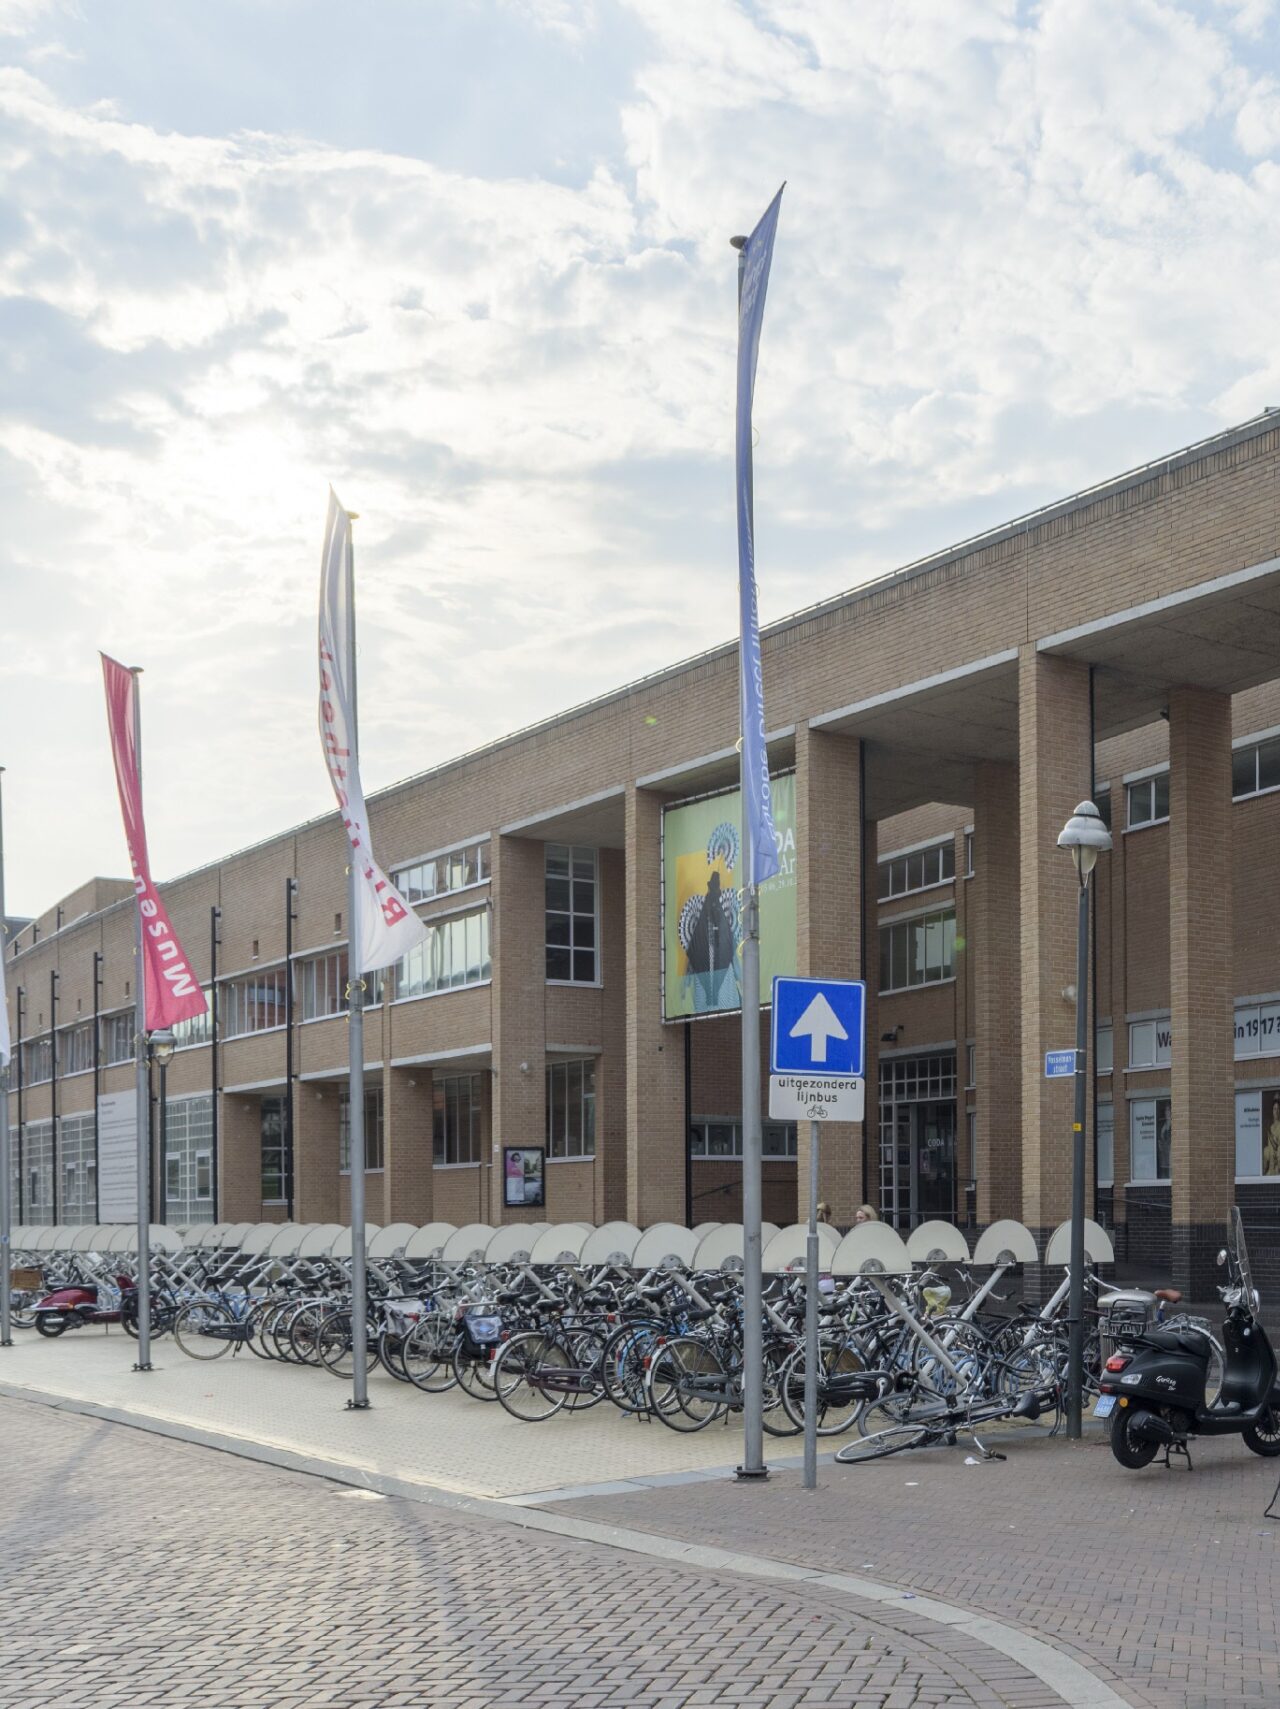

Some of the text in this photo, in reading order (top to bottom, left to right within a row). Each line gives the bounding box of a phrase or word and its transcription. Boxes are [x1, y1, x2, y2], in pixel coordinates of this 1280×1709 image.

[129, 858, 197, 998] Museu
[778, 1077, 857, 1091] uitgezonderd
[797, 1091, 838, 1105] lijnbus
[927, 1138, 945, 1148] CODA
